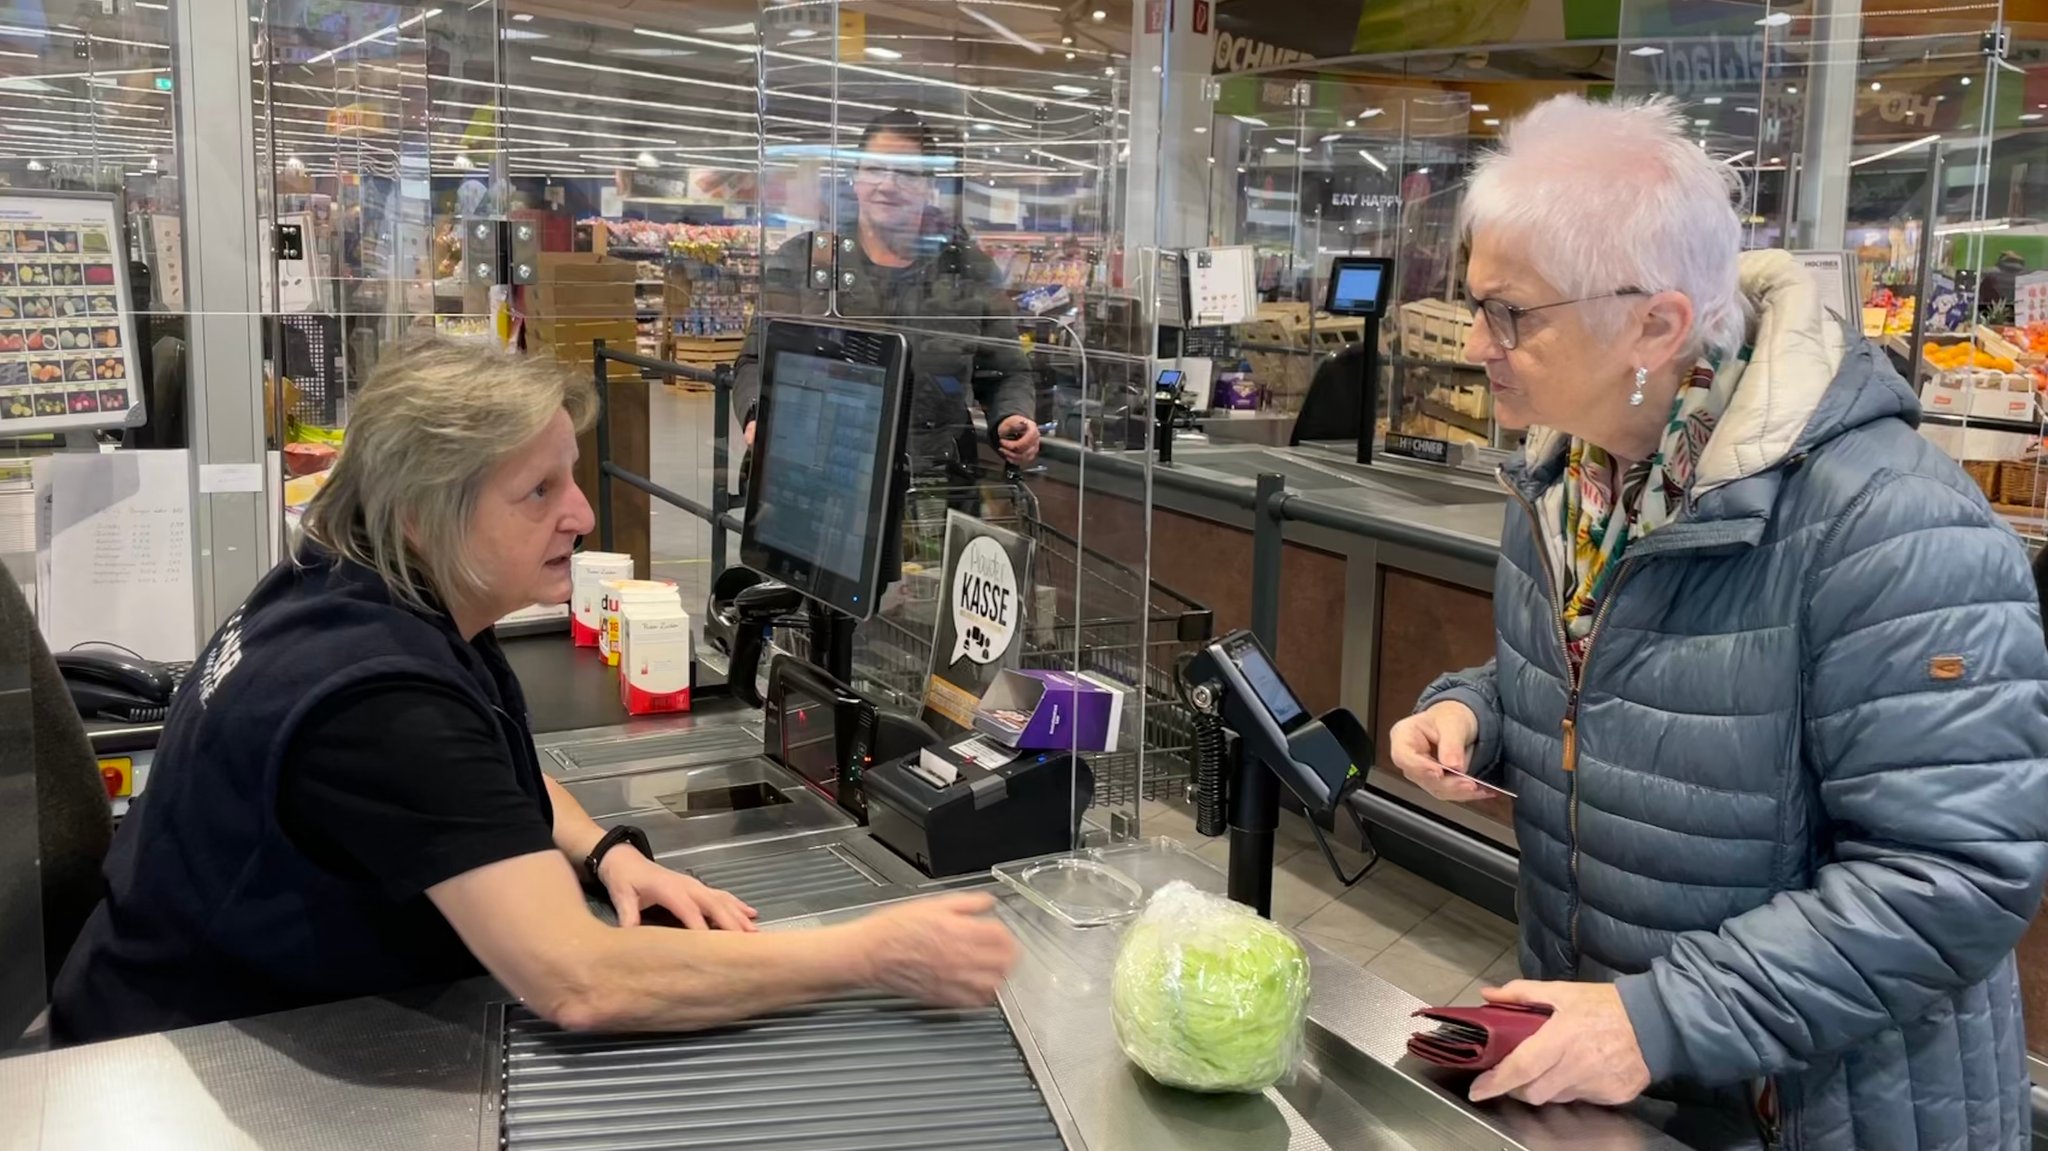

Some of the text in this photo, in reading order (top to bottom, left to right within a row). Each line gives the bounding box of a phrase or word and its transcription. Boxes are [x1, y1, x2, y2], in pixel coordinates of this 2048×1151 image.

[1213, 29, 1317, 73] OCHN
[1332, 193, 1402, 207] EAT HAPPY
[1399, 437, 1443, 454] HCHNER
[960, 571, 1010, 627] KASSE
